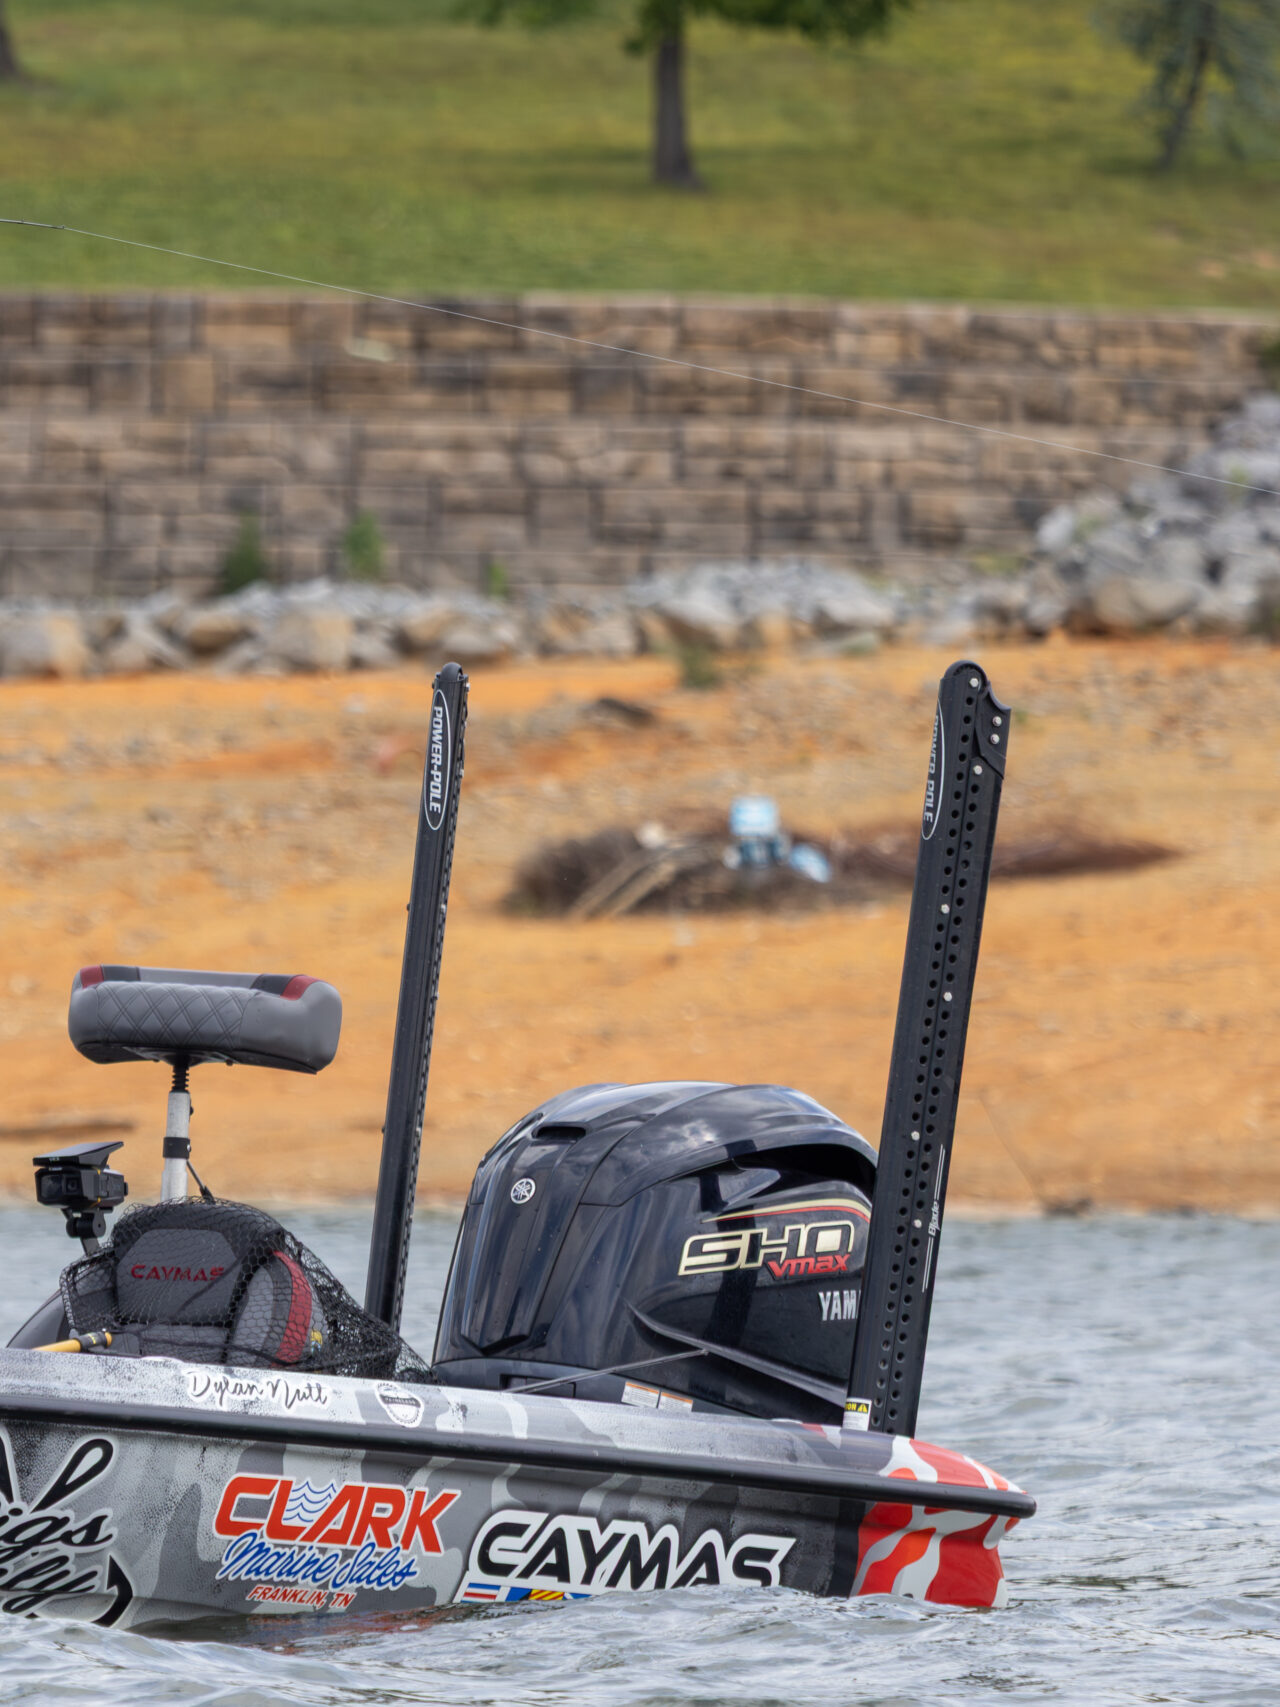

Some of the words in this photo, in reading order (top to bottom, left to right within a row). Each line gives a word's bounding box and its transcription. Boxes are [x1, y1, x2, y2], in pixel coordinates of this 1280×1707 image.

[429, 705, 443, 814] POWER-POLE
[928, 1201, 941, 1237] Blade
[678, 1219, 855, 1276] SHO
[131, 1263, 225, 1283] CAYMAS
[818, 1289, 862, 1322] YAM
[186, 1371, 264, 1407] Dylan
[214, 1475, 459, 1554] CLARK
[217, 1531, 340, 1584] Marine
[331, 1542, 417, 1589] Sales
[477, 1521, 780, 1591] CAYMAS
[330, 1591, 357, 1608] TN
